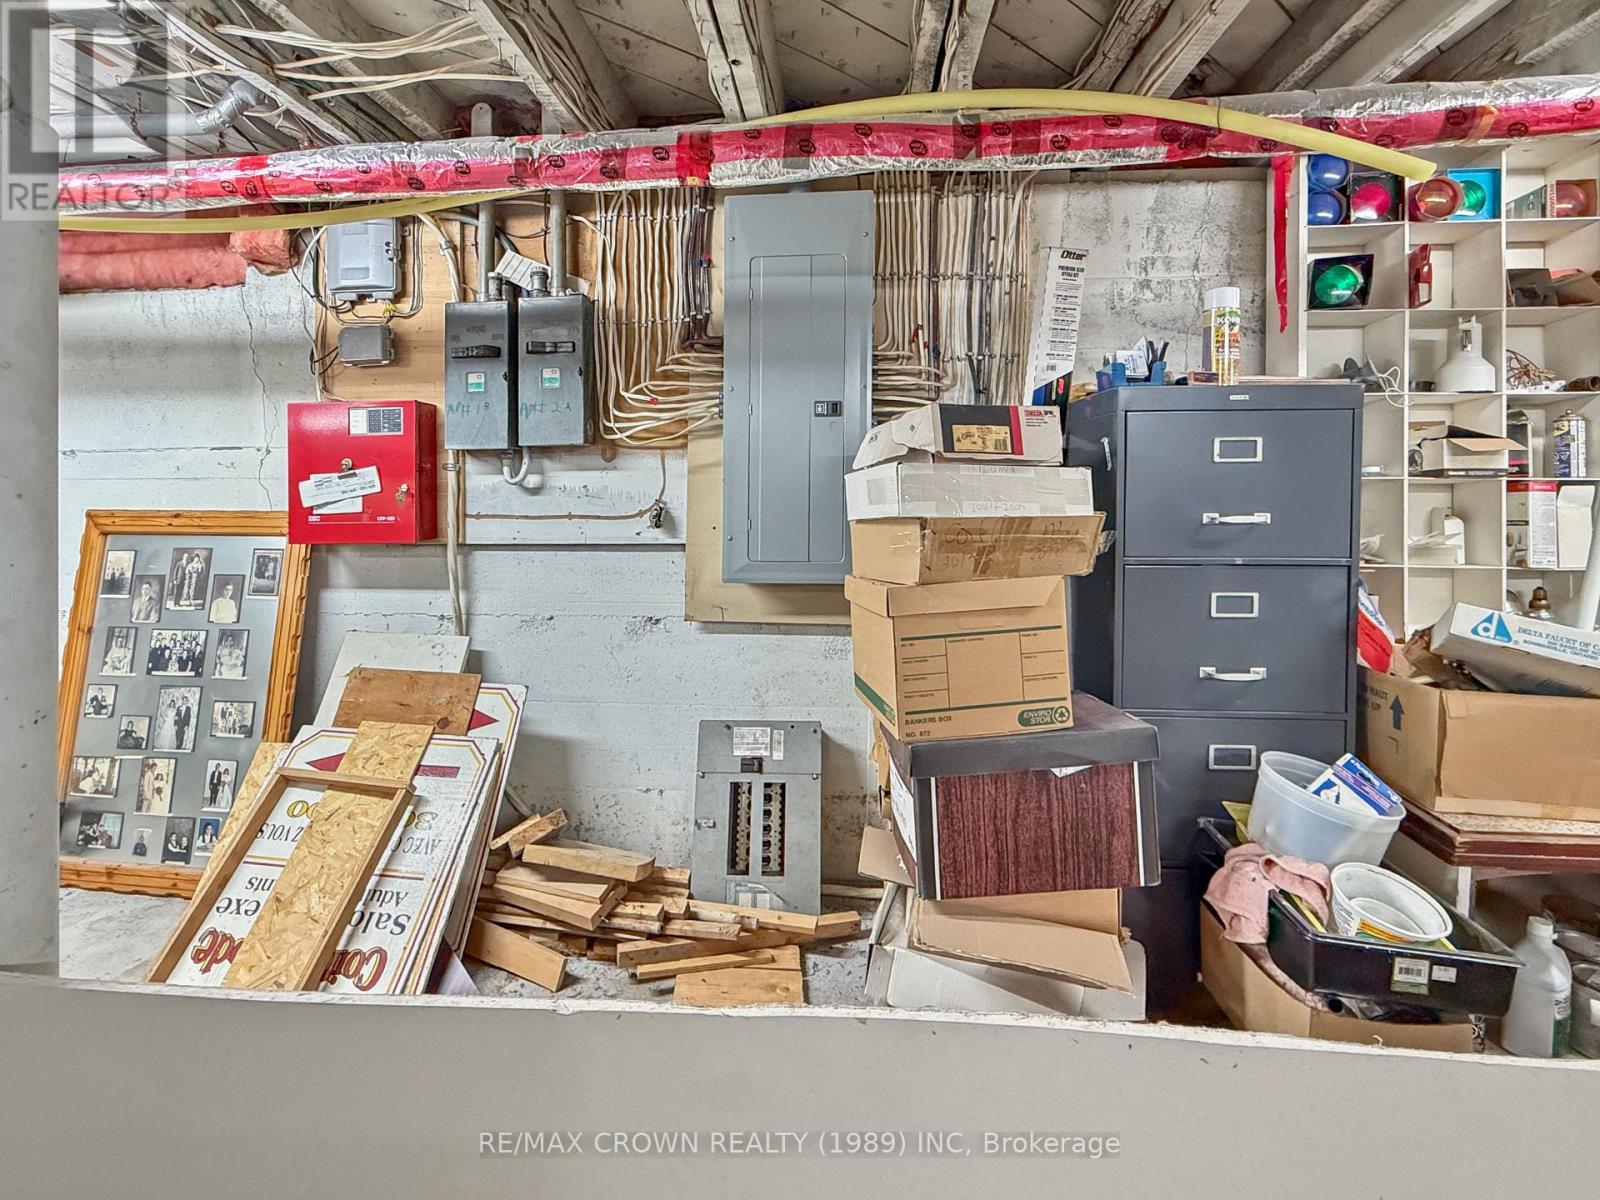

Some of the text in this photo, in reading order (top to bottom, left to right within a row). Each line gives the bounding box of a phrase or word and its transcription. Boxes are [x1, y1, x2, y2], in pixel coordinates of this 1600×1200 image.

[1060, 250, 1087, 261] Otter
[1517, 627, 1544, 639] DELTA
[1544, 632, 1578, 646] FAUCET
[904, 715, 952, 726] BANKERS BOX
[1023, 708, 1052, 719] ENVIRO
[403, 837, 442, 855] AVEC
[245, 876, 409, 908] Adul nts
[216, 897, 412, 936] Salo exe
